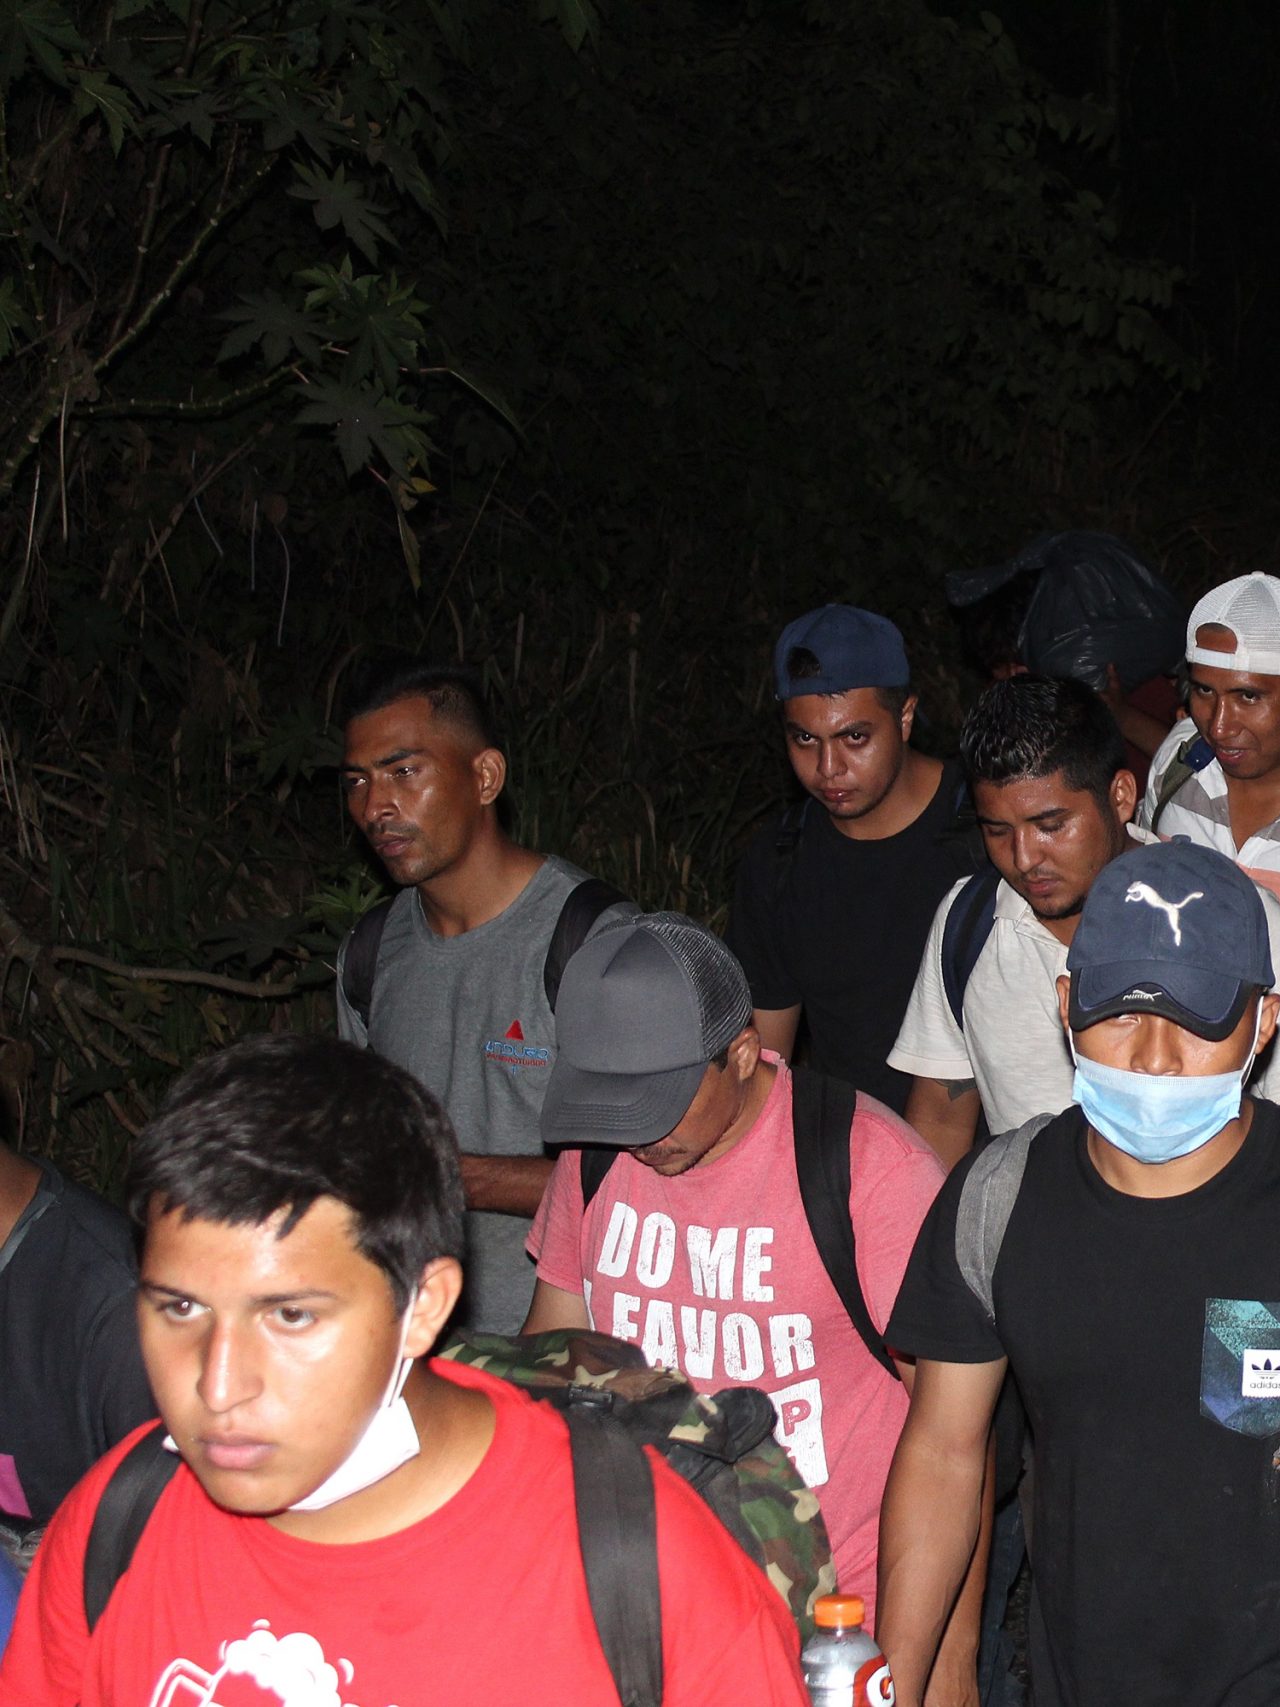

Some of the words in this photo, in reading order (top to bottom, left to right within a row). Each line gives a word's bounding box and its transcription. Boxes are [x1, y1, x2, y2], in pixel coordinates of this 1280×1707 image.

[597, 1201, 677, 1289] DO
[686, 1224, 775, 1303] ME
[611, 1291, 817, 1382] FAVOR
